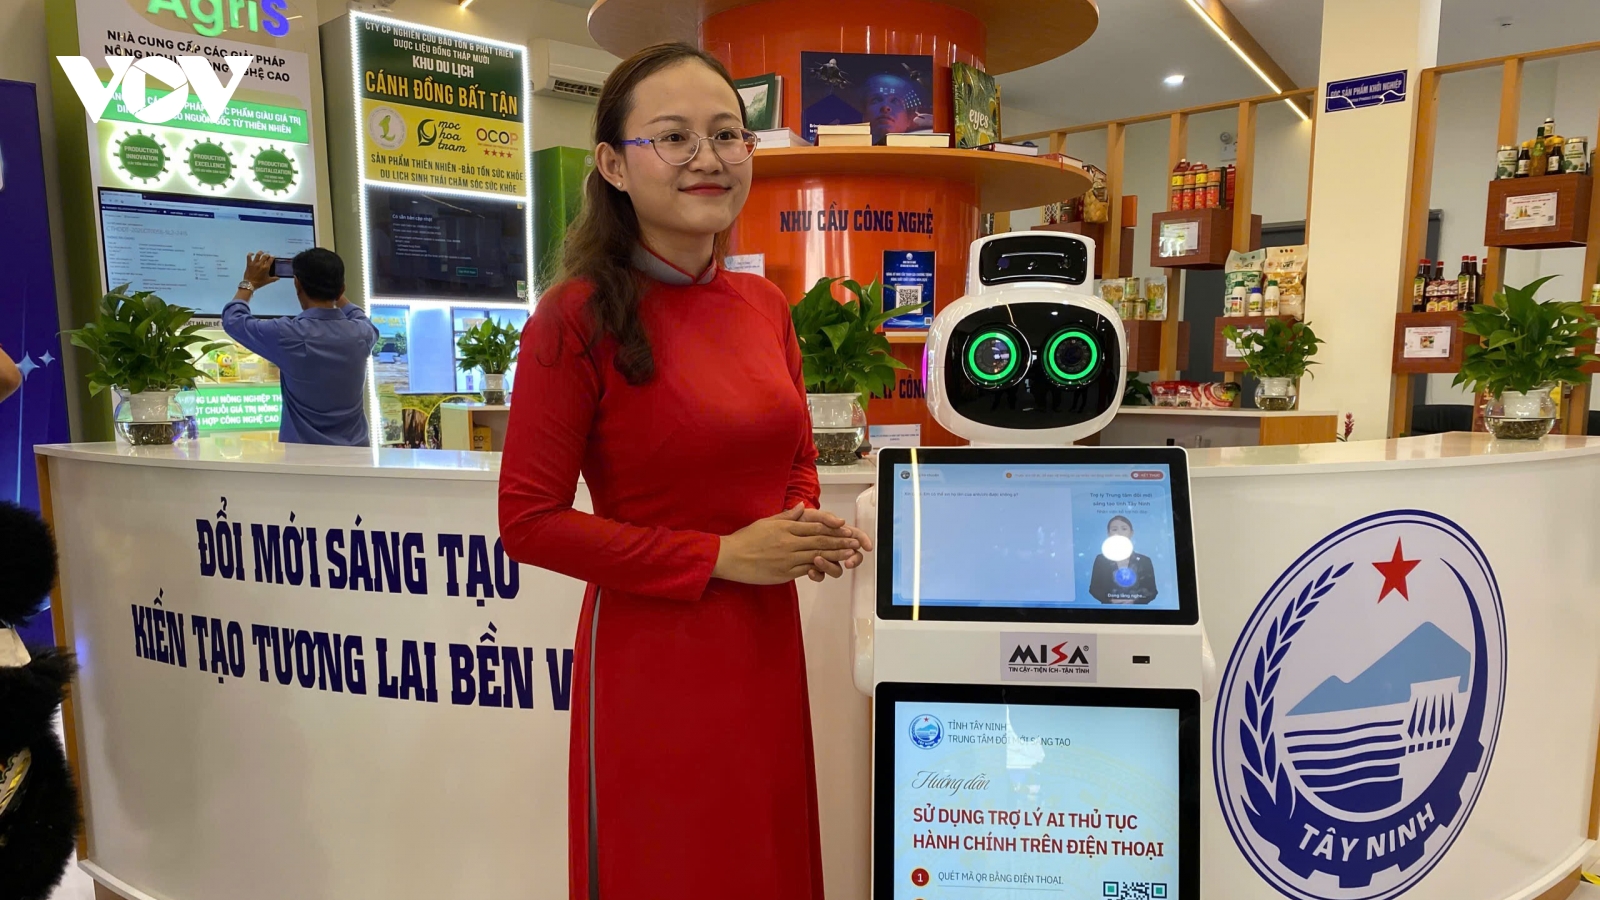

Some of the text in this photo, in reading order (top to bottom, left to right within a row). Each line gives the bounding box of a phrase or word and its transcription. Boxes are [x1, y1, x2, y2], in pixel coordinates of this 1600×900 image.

[366, 22, 380, 32] CTY
[382, 24, 391, 34] CP
[104, 44, 142, 59] NÔNG
[107, 30, 135, 43] NHÀ
[138, 36, 174, 49] CUNG
[204, 46, 228, 58] CÁC
[256, 55, 285, 67] PHÁP
[415, 42, 430, 54] LIỆU
[453, 50, 471, 61] THÁP
[472, 54, 490, 64] MƯỜI
[412, 55, 474, 78] KHU DU LỊCH
[267, 71, 290, 82] CAO
[366, 69, 518, 117] CÁNH ĐỒNG BẤT TẬN
[232, 118, 244, 128] TỪ
[244, 120, 267, 131] THIÊN
[268, 124, 292, 134] NHIÊN
[256, 110, 273, 120] GIÀU
[275, 112, 289, 122] GIÁ
[289, 116, 301, 126] TRỊ
[969, 109, 989, 130] eyes
[439, 129, 462, 141] hoa
[476, 128, 518, 145] OCOP
[124, 145, 158, 154] PRODUCTION
[194, 154, 226, 162] PRODUCTION
[255, 167, 292, 175] DIGITALIZATION
[257, 160, 288, 168] PRODUCTION
[371, 152, 386, 164] SẢN
[388, 154, 410, 167] PHẨM
[412, 158, 433, 170] THIÊN
[435, 162, 456, 172] NHIÊN
[506, 170, 524, 180] KHỎE
[380, 169, 390, 179] DU
[393, 170, 408, 181] LỊCH
[411, 173, 428, 182] SINH
[430, 174, 446, 185] THÁI
[448, 177, 468, 188] CHĂM
[470, 179, 483, 189] SÓC
[500, 182, 517, 193] KHỎE
[780, 202, 933, 239] NHU CẦU CÔNG NGHỆ
[899, 374, 925, 399] CÔN
[220, 393, 240, 403] NÔNG
[243, 393, 270, 403] NGHIỆP
[230, 404, 243, 413] GIÁ
[245, 405, 256, 414] TRỊ
[258, 404, 279, 412] NÔNG
[202, 416, 219, 426] HỢP
[221, 415, 240, 424] CÔNG
[243, 415, 264, 424] NGHỆ
[196, 496, 520, 607] ĐỔI MỚI SÁNG TẠO
[131, 588, 534, 709] KIẾN TẠO TƯƠNG LAI BỀN
[1008, 641, 1089, 666] MISA
[948, 720, 967, 730] TỈNH
[970, 721, 984, 730] TÂY
[948, 735, 975, 744] TRUNG
[978, 734, 993, 744] TÂM
[1055, 738, 1070, 747] TẠO
[912, 771, 990, 796] Hướng dẫn
[913, 803, 1138, 833] SỬ DỤNG TRỢ LÝ AI THỦ TỤC
[1299, 802, 1435, 862] TÂY NINH
[913, 830, 1164, 860] HÀNH CHÍNH TRÊN ĐIỆN THOẠI
[918, 870, 1064, 885] 1 QUÉT MÃ QR BẰNG ĐIỆN THOẠI.
